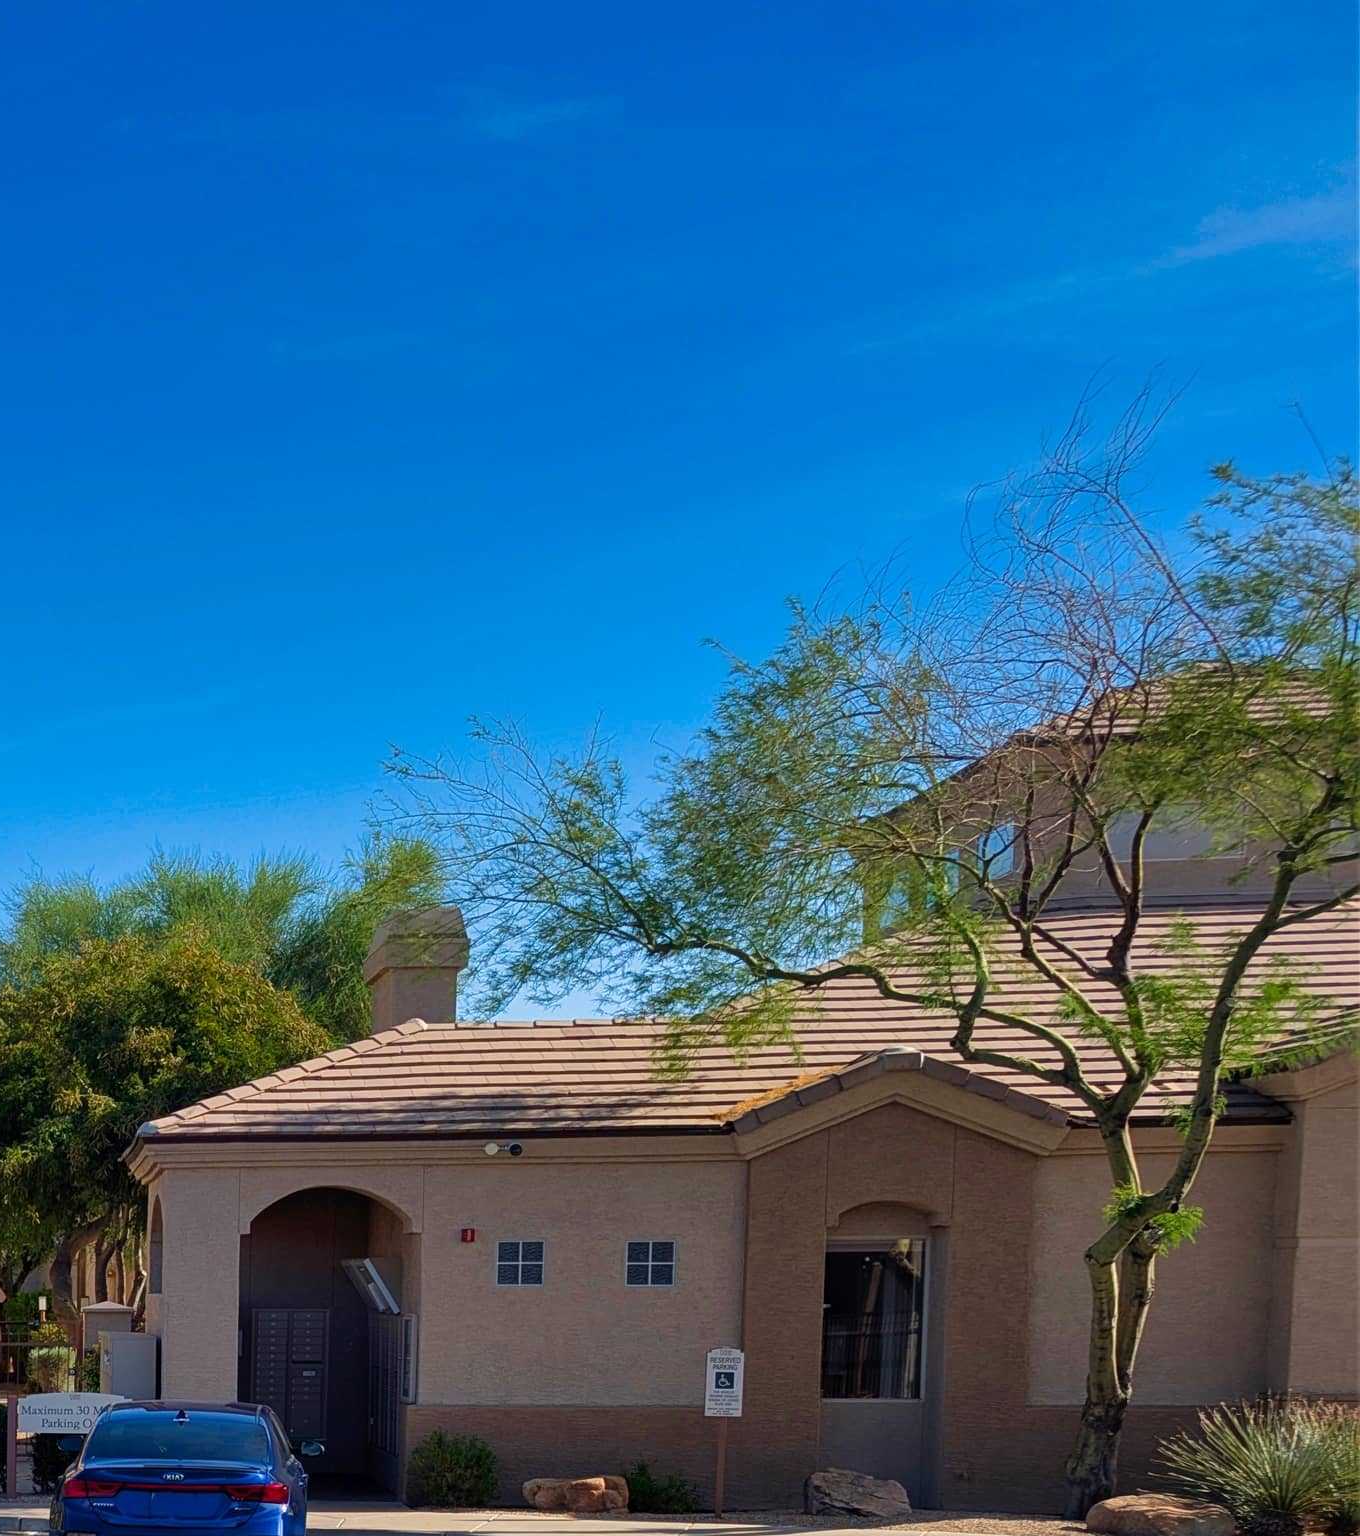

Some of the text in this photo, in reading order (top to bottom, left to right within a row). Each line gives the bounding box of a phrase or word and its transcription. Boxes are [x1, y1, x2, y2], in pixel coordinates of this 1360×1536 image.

[21, 1405, 74, 1416] Maximum
[76, 1405, 90, 1416] 30
[41, 1418, 80, 1430] Parking
